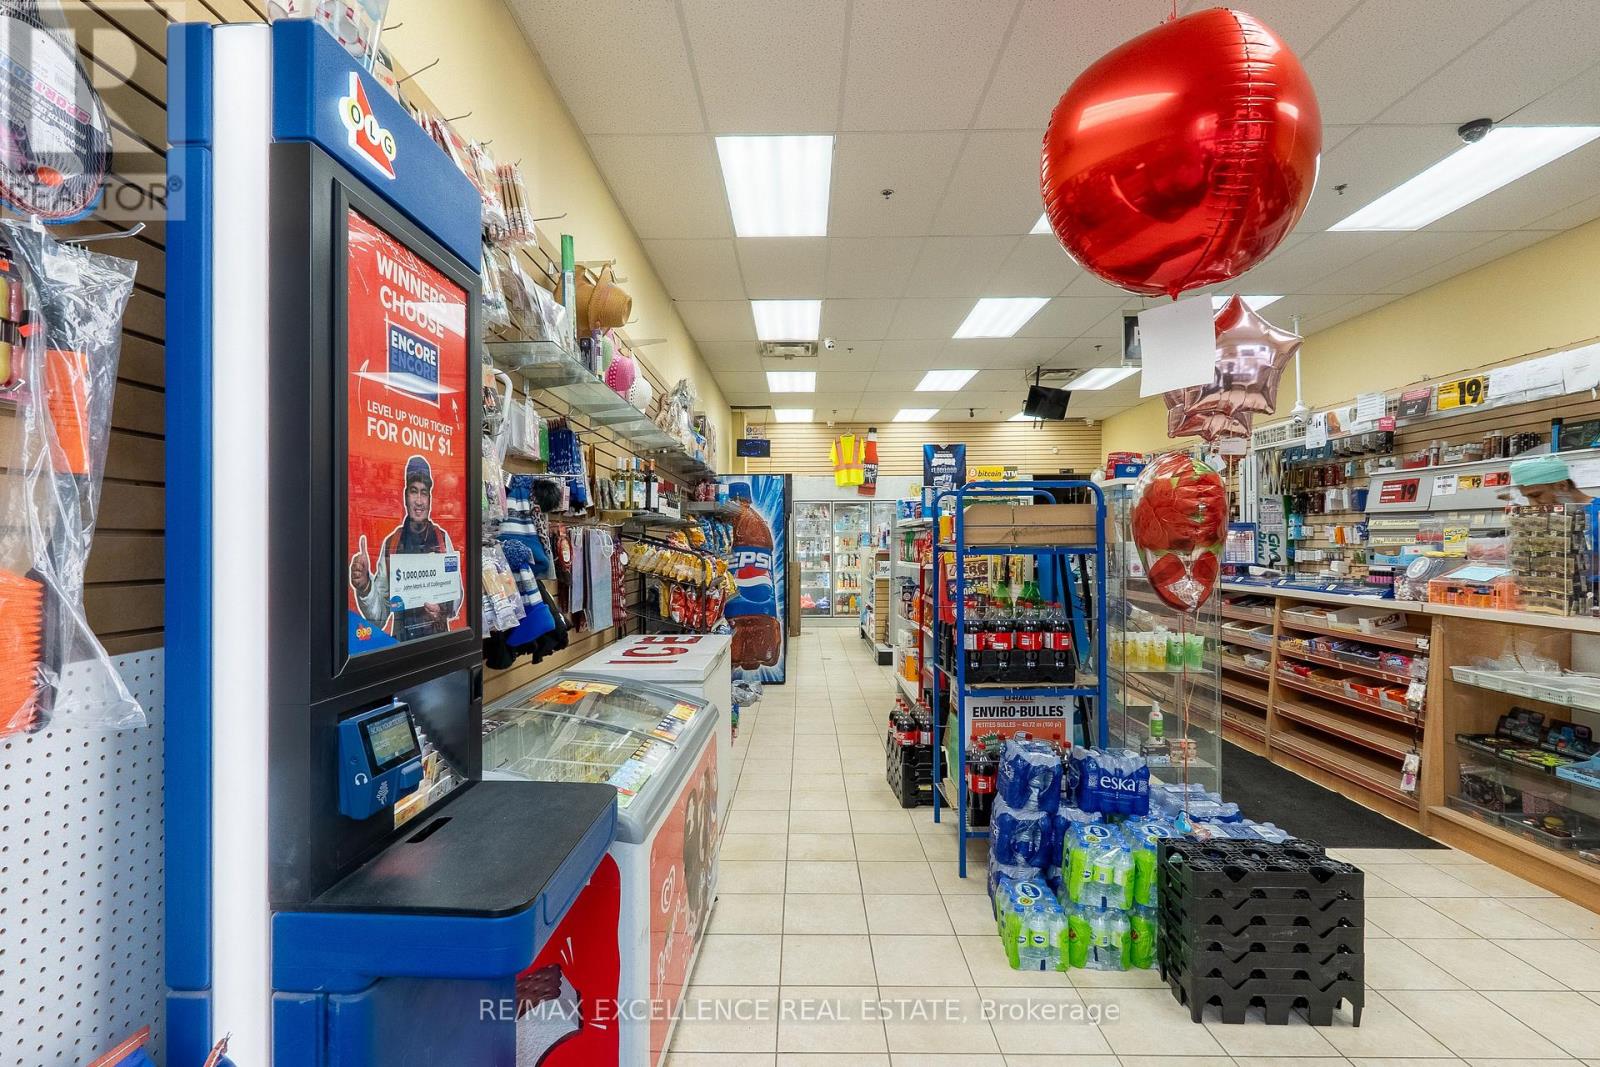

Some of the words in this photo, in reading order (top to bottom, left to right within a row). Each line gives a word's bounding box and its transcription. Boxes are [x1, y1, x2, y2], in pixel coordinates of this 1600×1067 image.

[351, 104, 392, 155] OLG
[376, 250, 447, 312] WINNERS
[380, 285, 444, 339] CHOOSE
[391, 330, 437, 366] ENCORE
[391, 350, 437, 381] ENCORE
[1457, 379, 1482, 405] 19
[367, 400, 393, 419] LEVEL
[395, 409, 407, 422] UP
[408, 413, 429, 430] YOUR
[430, 420, 454, 436] TICKET
[367, 416, 398, 443] FOR
[401, 426, 435, 452] ONLY
[438, 436, 454, 456] $1.
[977, 469, 1002, 478] bitcoin
[1471, 477, 1482, 488] 19
[1496, 472, 1509, 485] 19
[1401, 484, 1417, 499] 19
[727, 551, 772, 570] EPSI
[605, 636, 703, 664] ICE
[1100, 776, 1136, 792] eska
